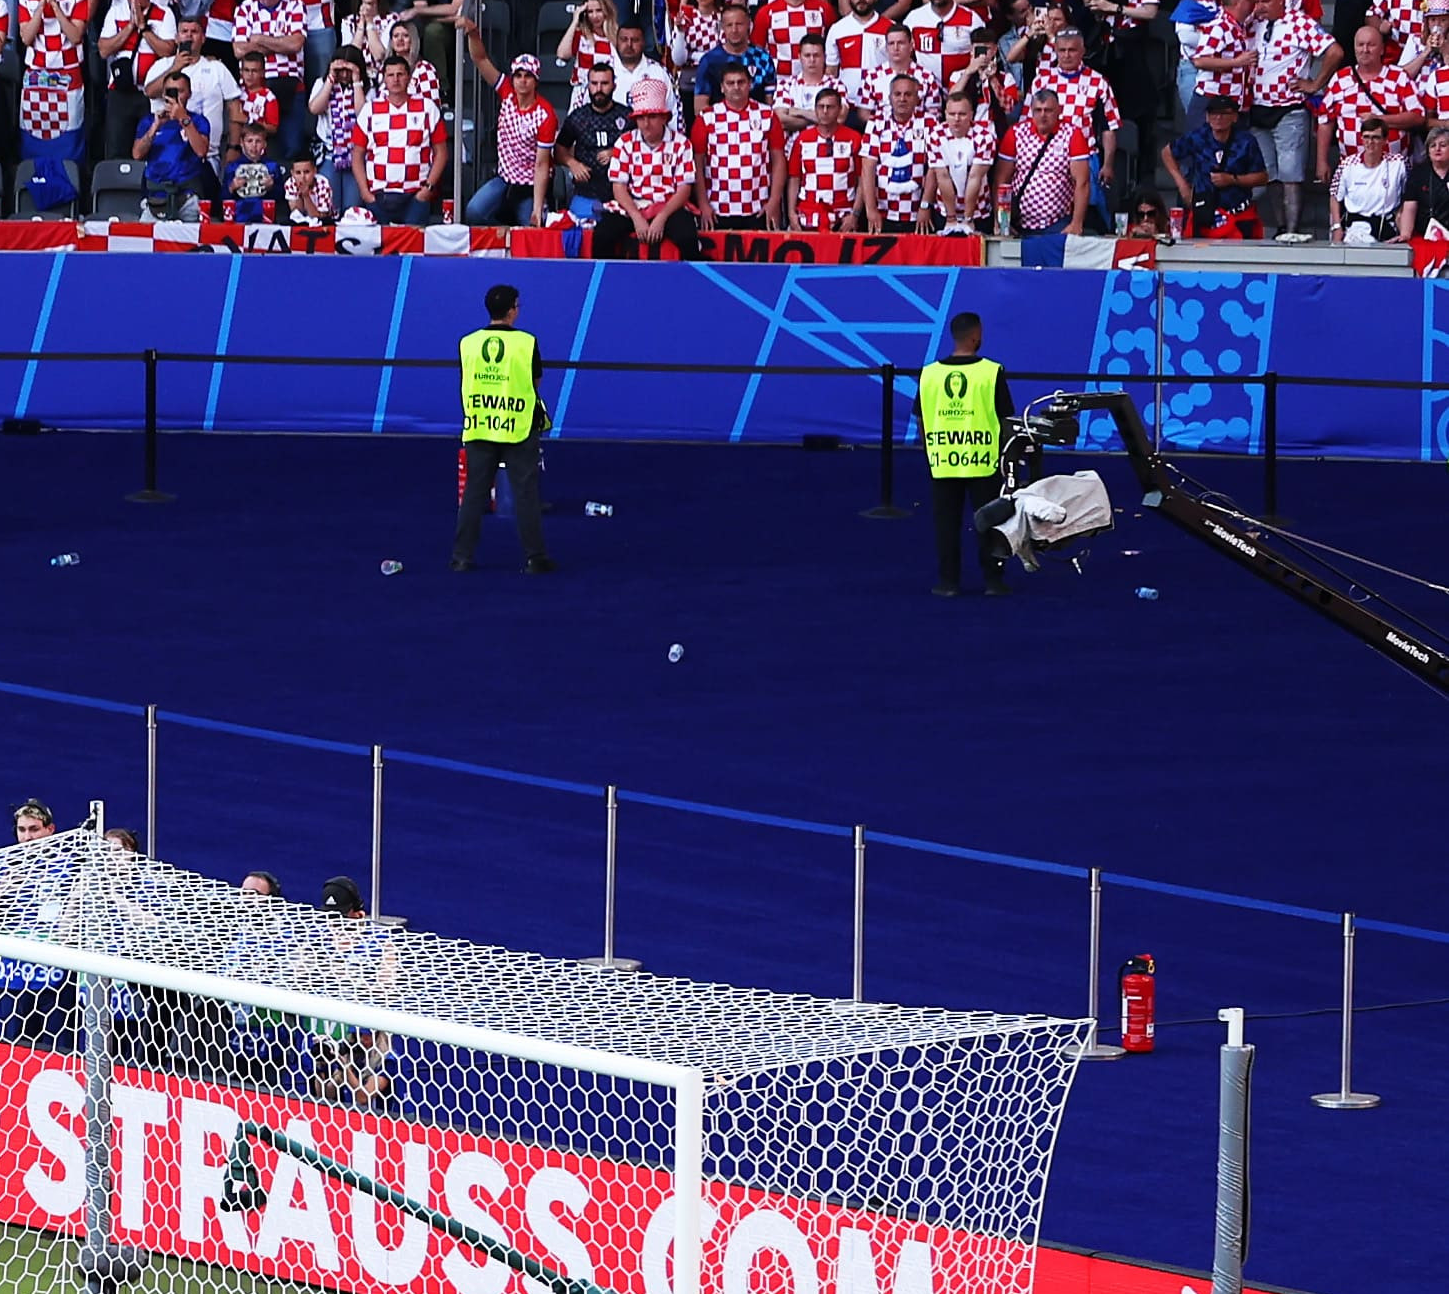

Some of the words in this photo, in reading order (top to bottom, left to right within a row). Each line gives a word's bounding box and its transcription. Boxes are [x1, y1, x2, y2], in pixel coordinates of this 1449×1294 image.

[919, 34, 932, 51] 10
[596, 132, 608, 147] 10
[466, 395, 526, 413] TEWARD
[926, 430, 992, 447] STEWARD
[929, 451, 990, 468] 01-0644
[1212, 523, 1257, 558] MovieTech
[1386, 630, 1430, 664] MovieTech
